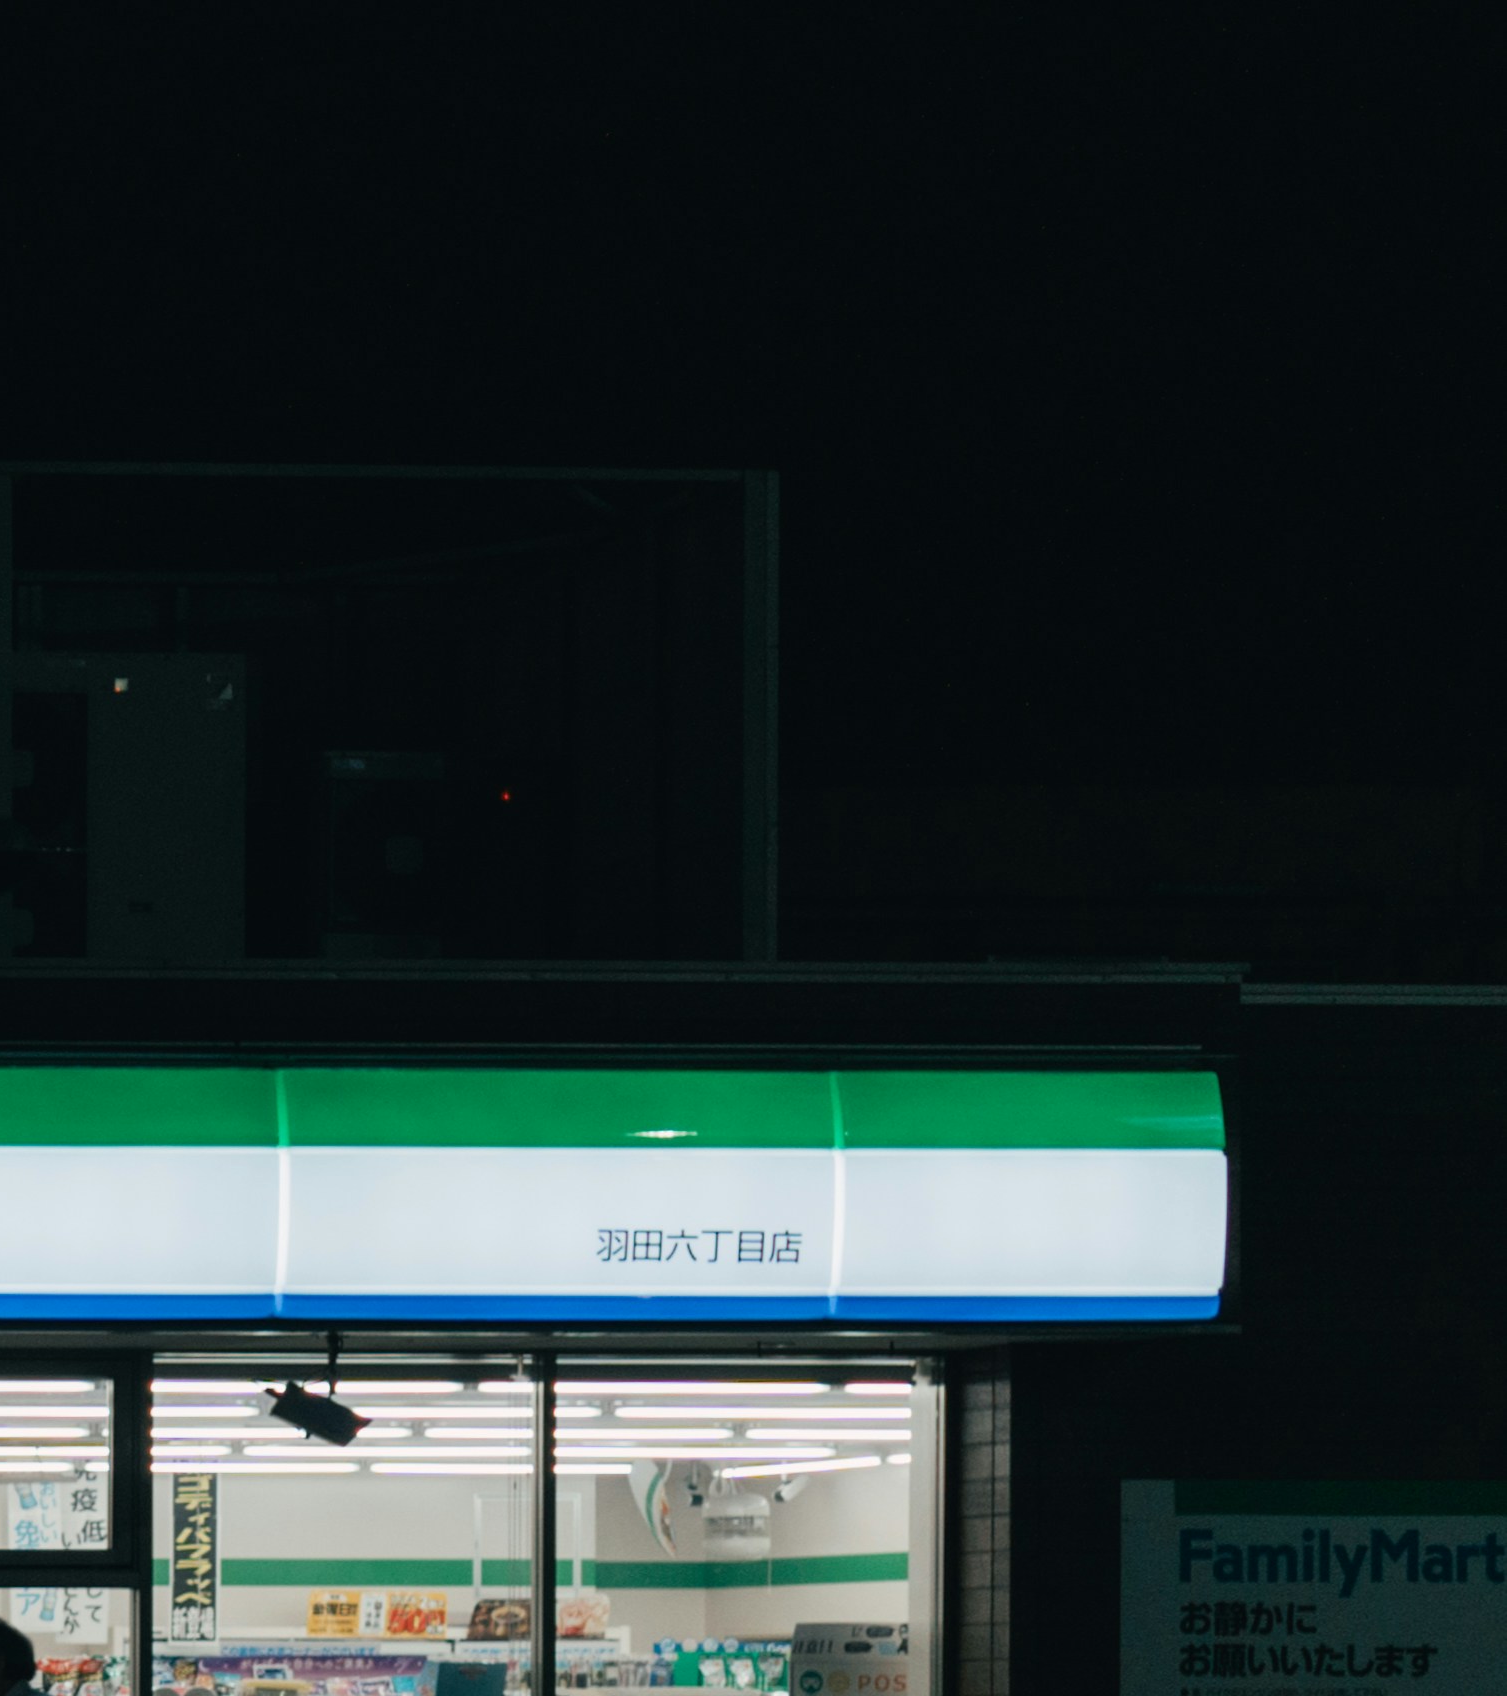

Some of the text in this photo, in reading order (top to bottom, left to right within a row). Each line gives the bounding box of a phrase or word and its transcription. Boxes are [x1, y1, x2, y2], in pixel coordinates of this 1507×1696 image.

[596, 1229, 802, 1263] 羽田六丁目店
[1179, 1527, 1505, 1599] FamilyMart
[1180, 1601, 1317, 1636] お静かに
[1180, 1643, 1438, 1678] お願いいたします
